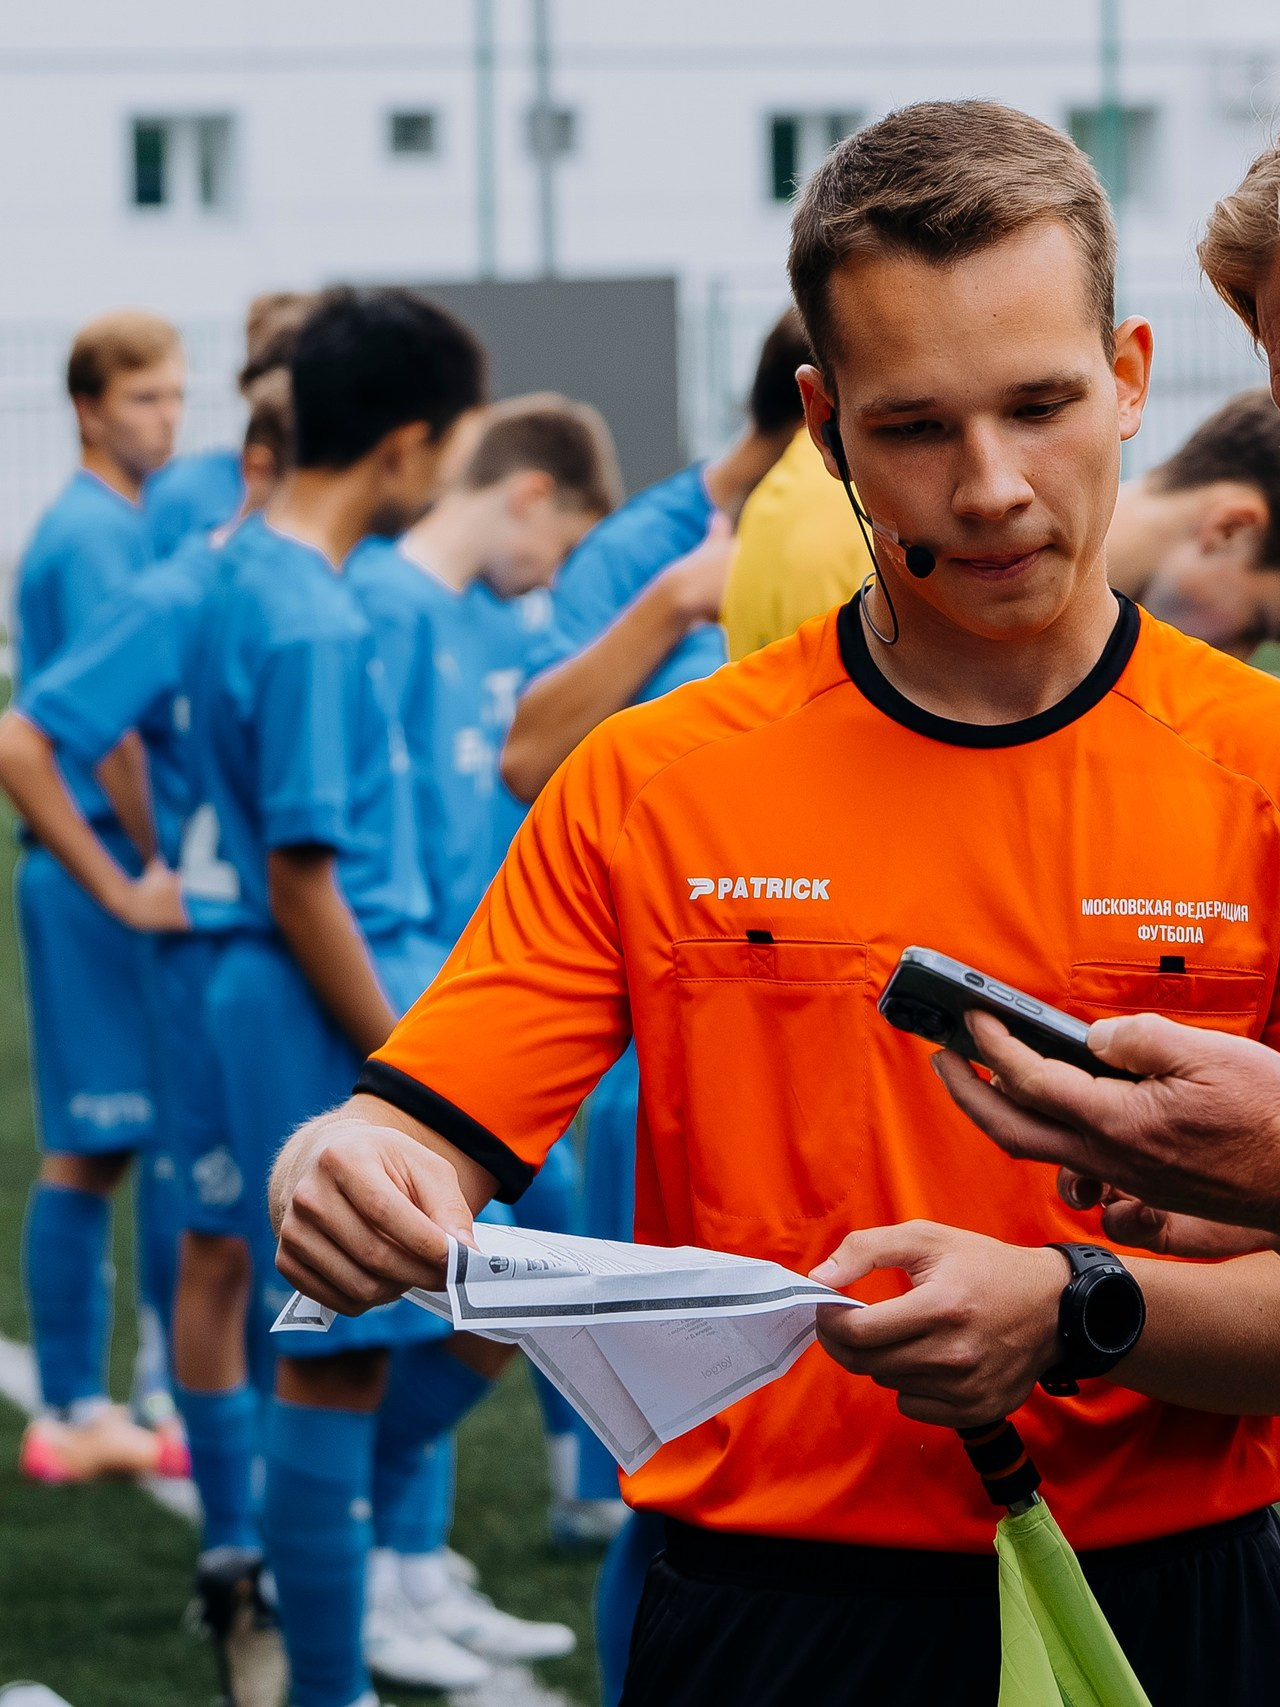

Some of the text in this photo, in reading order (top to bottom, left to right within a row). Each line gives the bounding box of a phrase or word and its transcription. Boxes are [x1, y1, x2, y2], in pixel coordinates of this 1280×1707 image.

[717, 877, 830, 900] PATRICK
[1081, 898, 1249, 922] МОСКОВСКАЯ ФЕДЕРАЦИЯ
[1137, 925, 1204, 944] ФУТБОЛА
